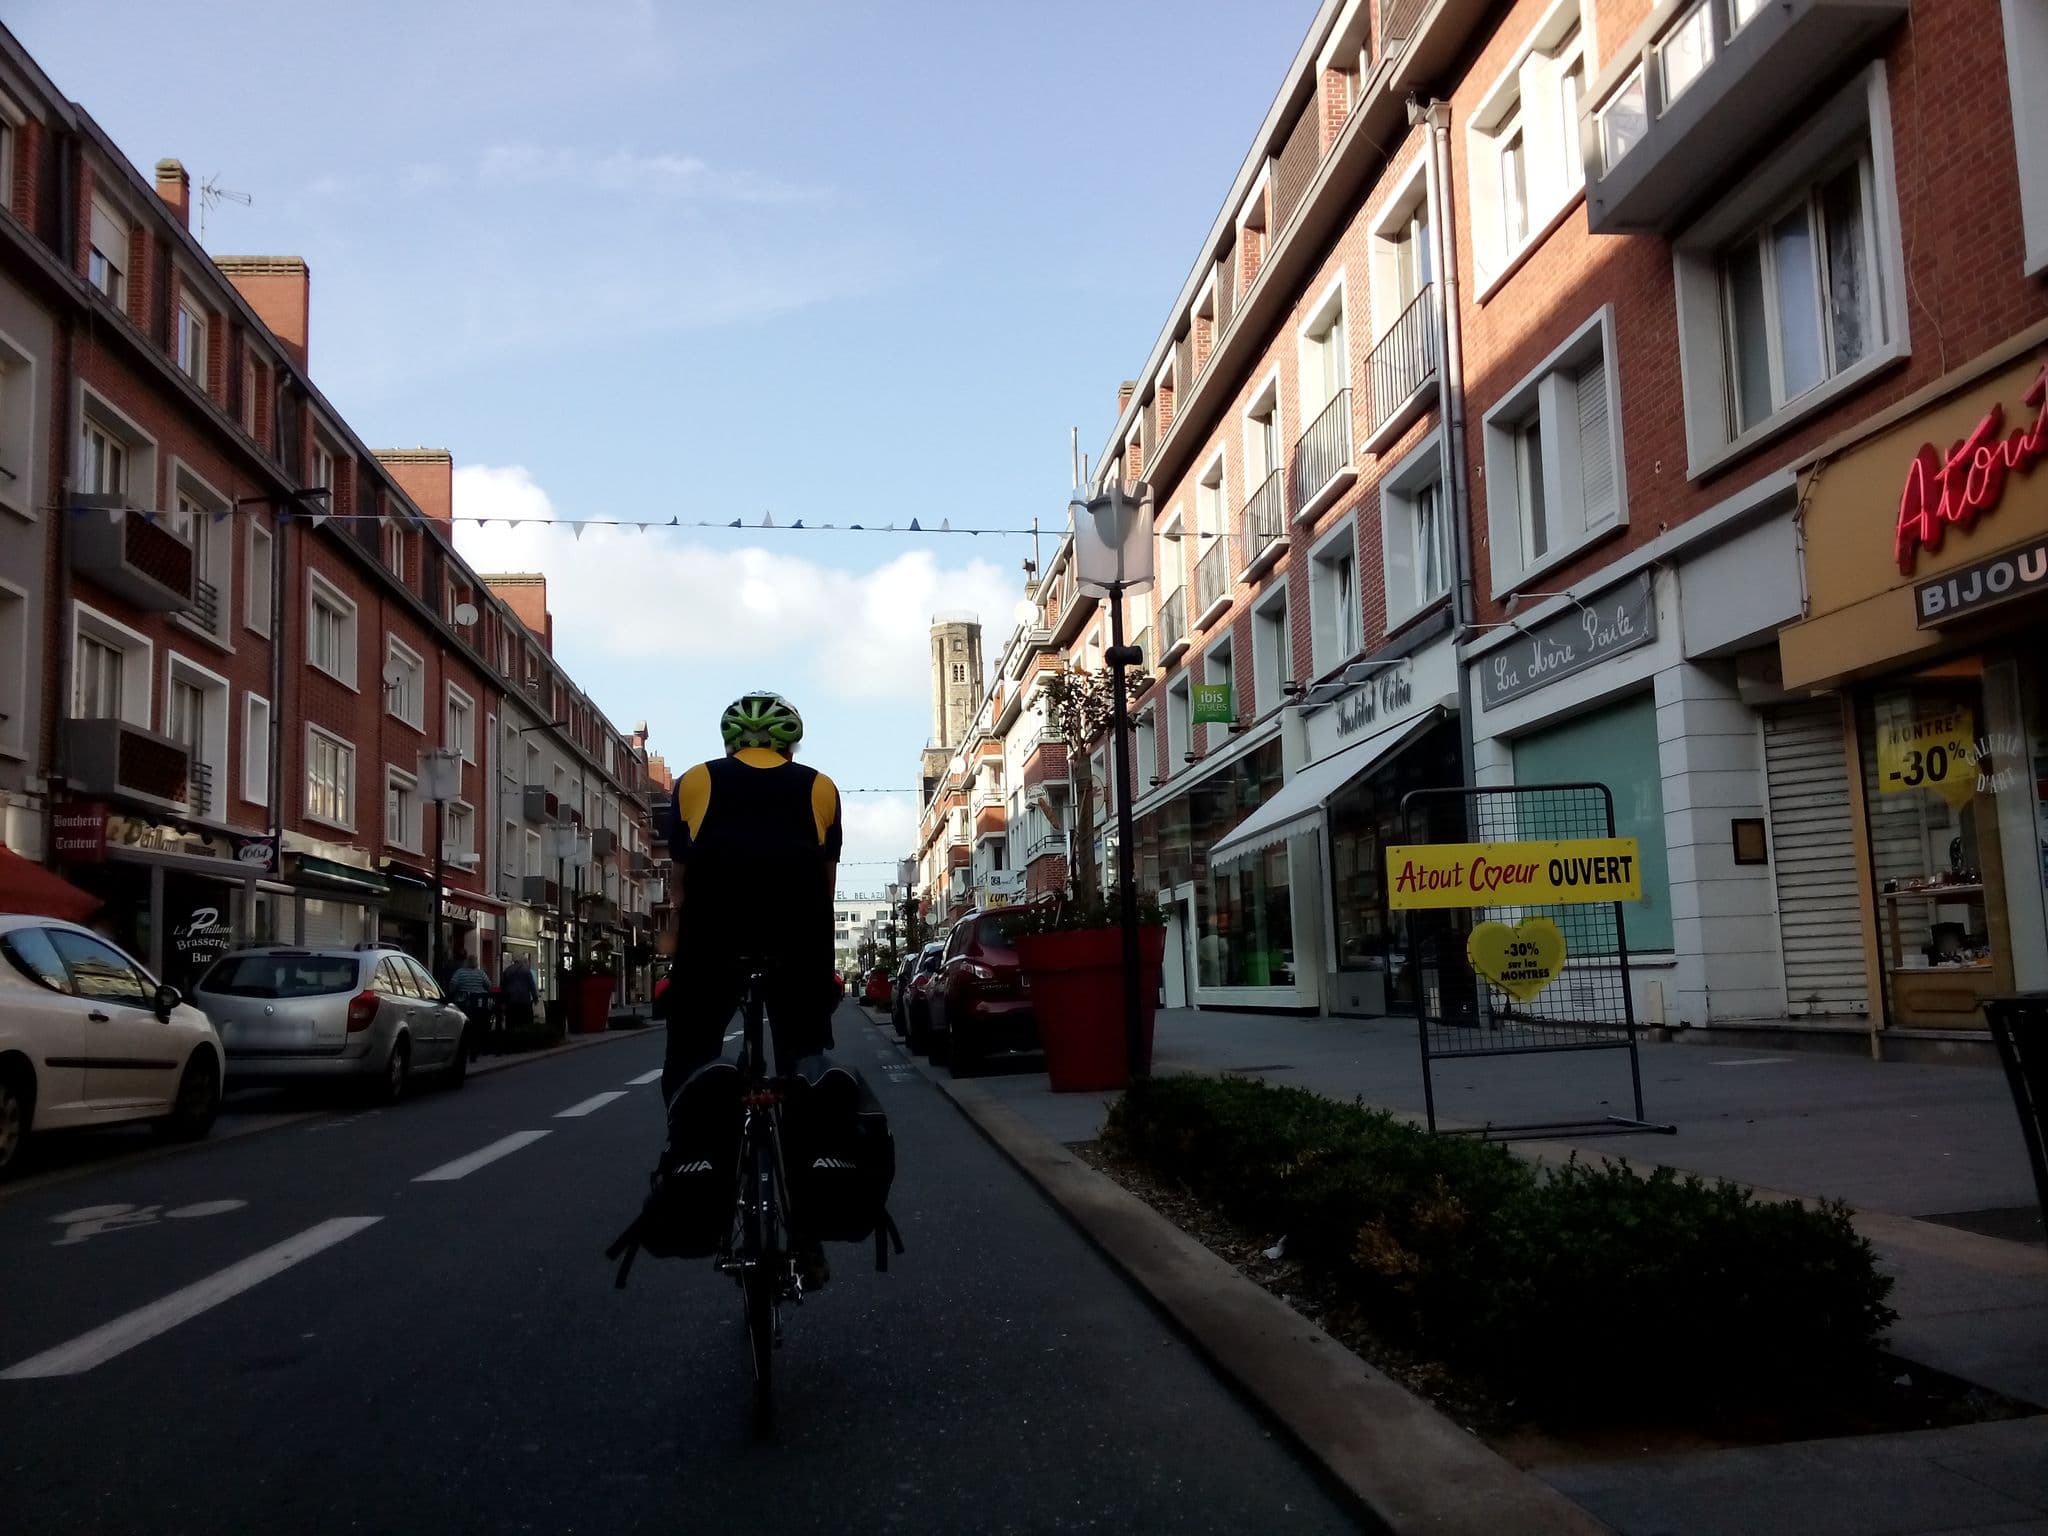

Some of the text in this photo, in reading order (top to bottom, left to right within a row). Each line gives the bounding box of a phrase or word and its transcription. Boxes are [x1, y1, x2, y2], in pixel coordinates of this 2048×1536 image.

[1495, 657, 1520, 692] La
[1201, 691, 1223, 703] ibis
[55, 836, 98, 850] Traiteur
[1396, 859, 1464, 893] Atout
[1548, 855, 1633, 886] OUVERT
[854, 892, 868, 900] BEL
[176, 937, 230, 951] Brasserie
[1504, 942, 1540, 957] -30%
[192, 952, 212, 963] Bar
[1508, 959, 1537, 969] sur les
[1501, 968, 1550, 981] MONTRES
